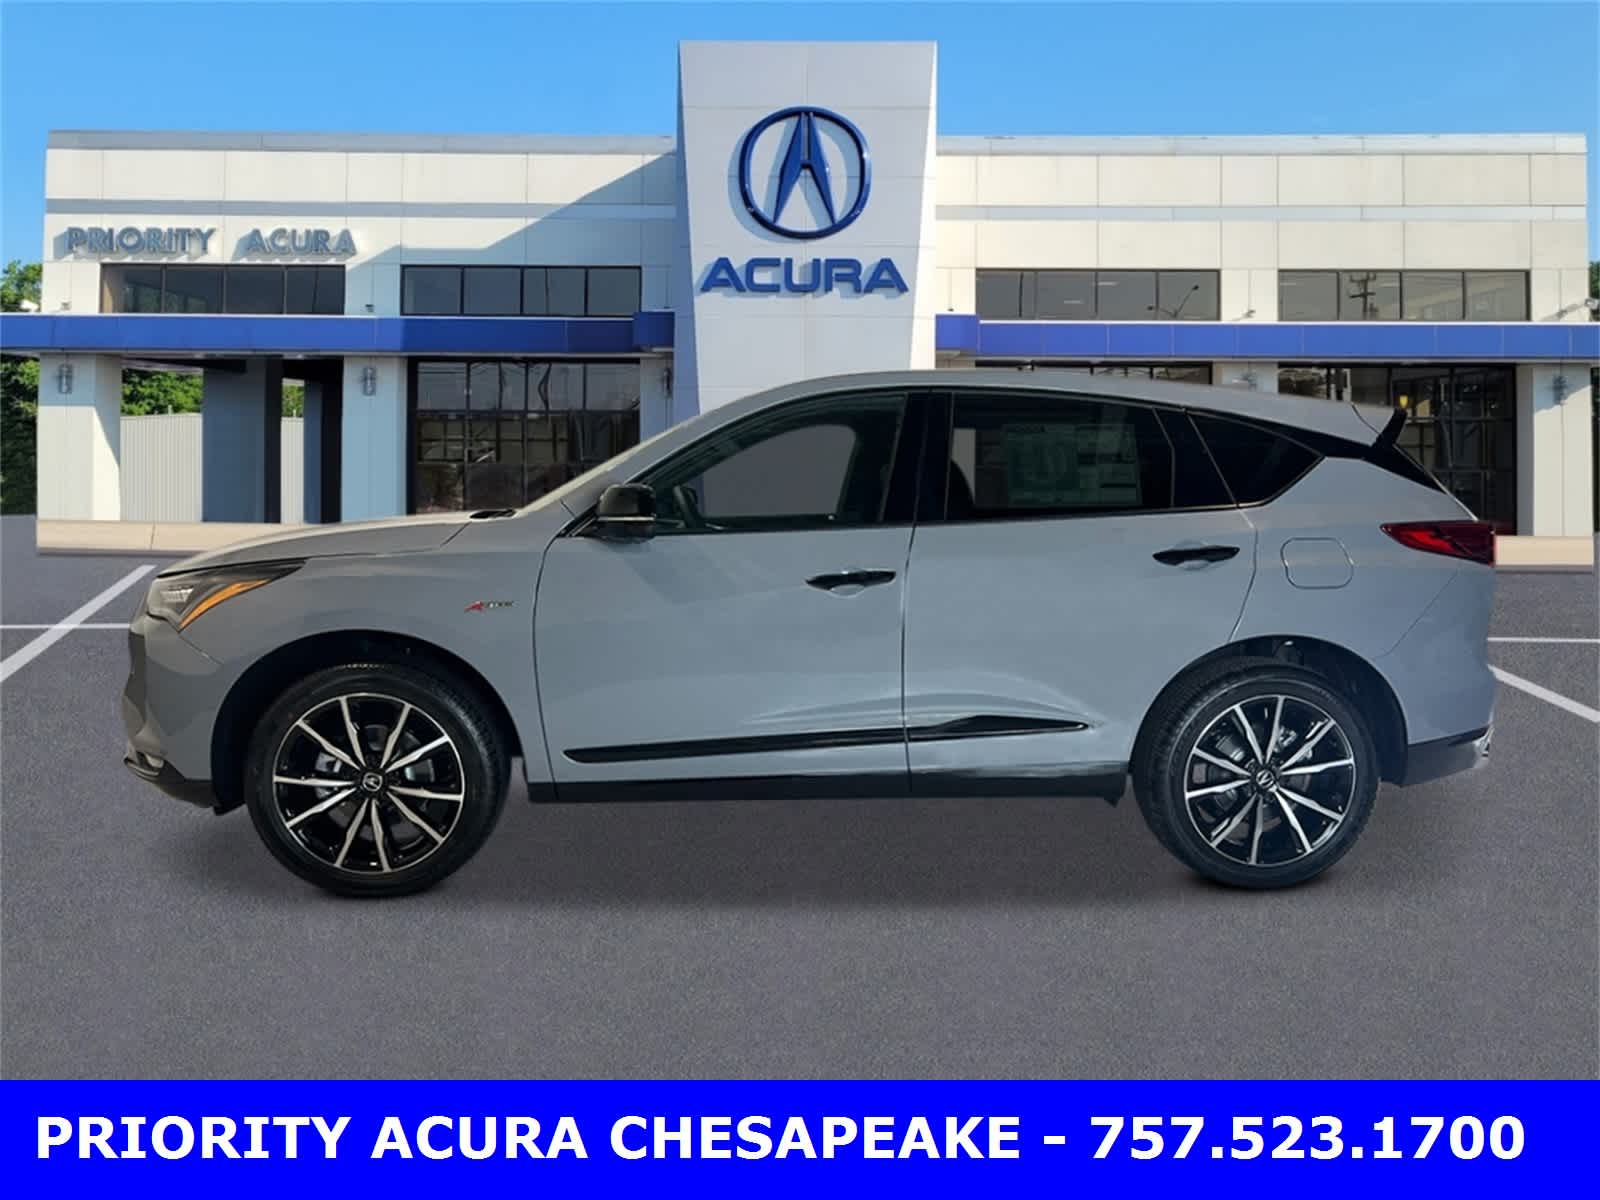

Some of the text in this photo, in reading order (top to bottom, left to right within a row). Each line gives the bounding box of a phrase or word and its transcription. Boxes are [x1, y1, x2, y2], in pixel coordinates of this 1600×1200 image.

[65, 226, 357, 254] PRIORITY ACURA
[700, 257, 909, 293] ACURA
